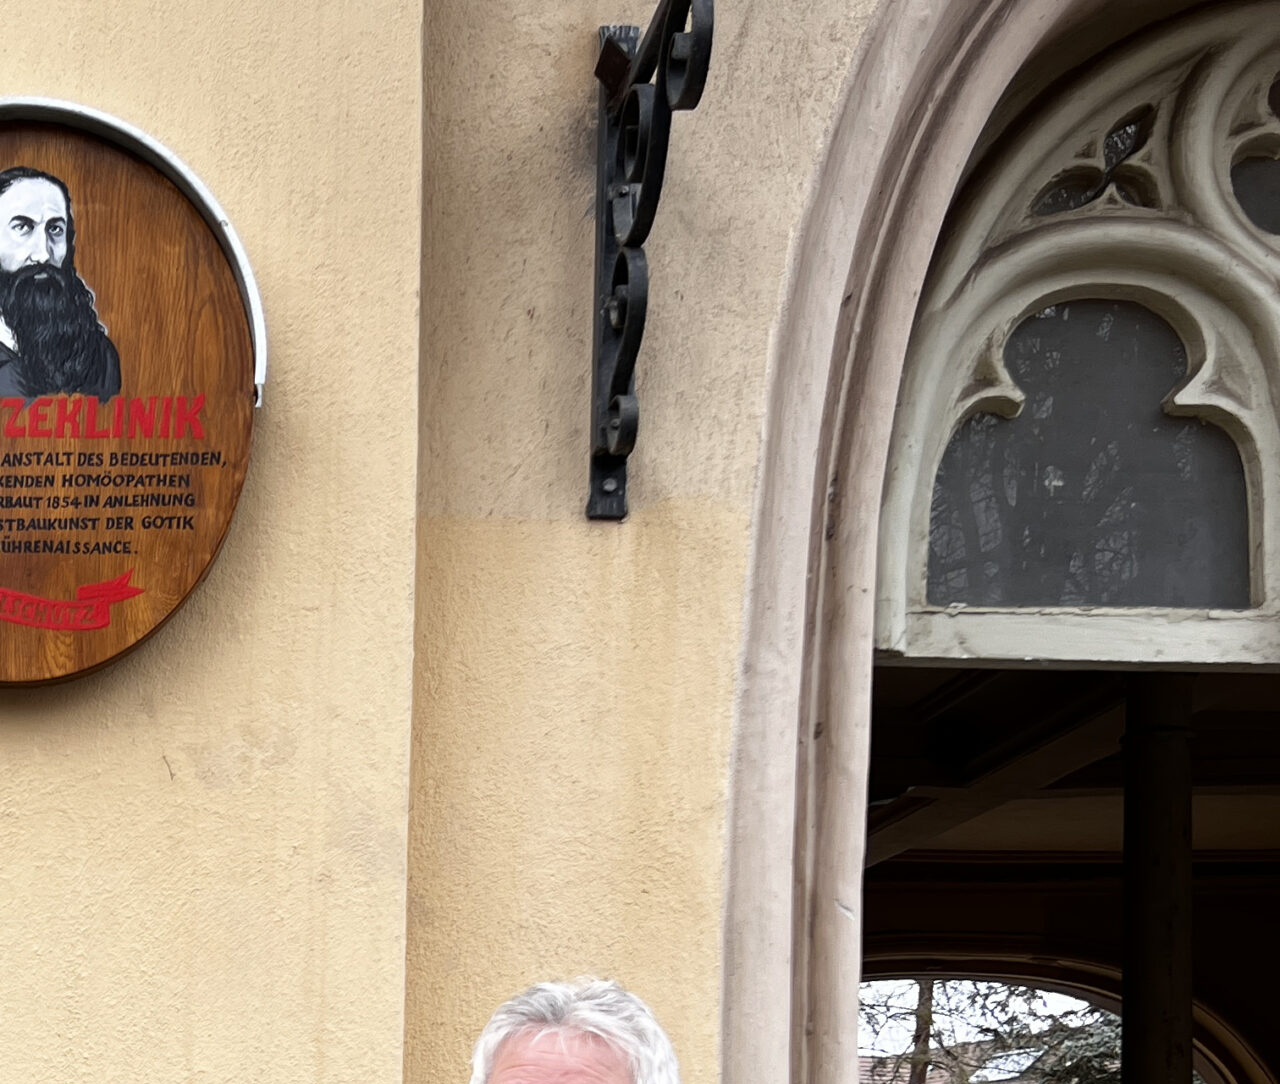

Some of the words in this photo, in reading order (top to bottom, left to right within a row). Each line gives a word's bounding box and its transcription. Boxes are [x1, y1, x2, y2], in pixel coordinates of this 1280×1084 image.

[77, 452, 103, 467] DES
[109, 451, 227, 468] BEDEUTENDEN,
[62, 470, 190, 488] HOMÖOPATHEN
[46, 496, 81, 509] 1854
[83, 495, 99, 508] IN
[102, 493, 196, 508] ANLEHNUNG
[105, 516, 134, 531] DER
[141, 515, 195, 531] GOTIK
